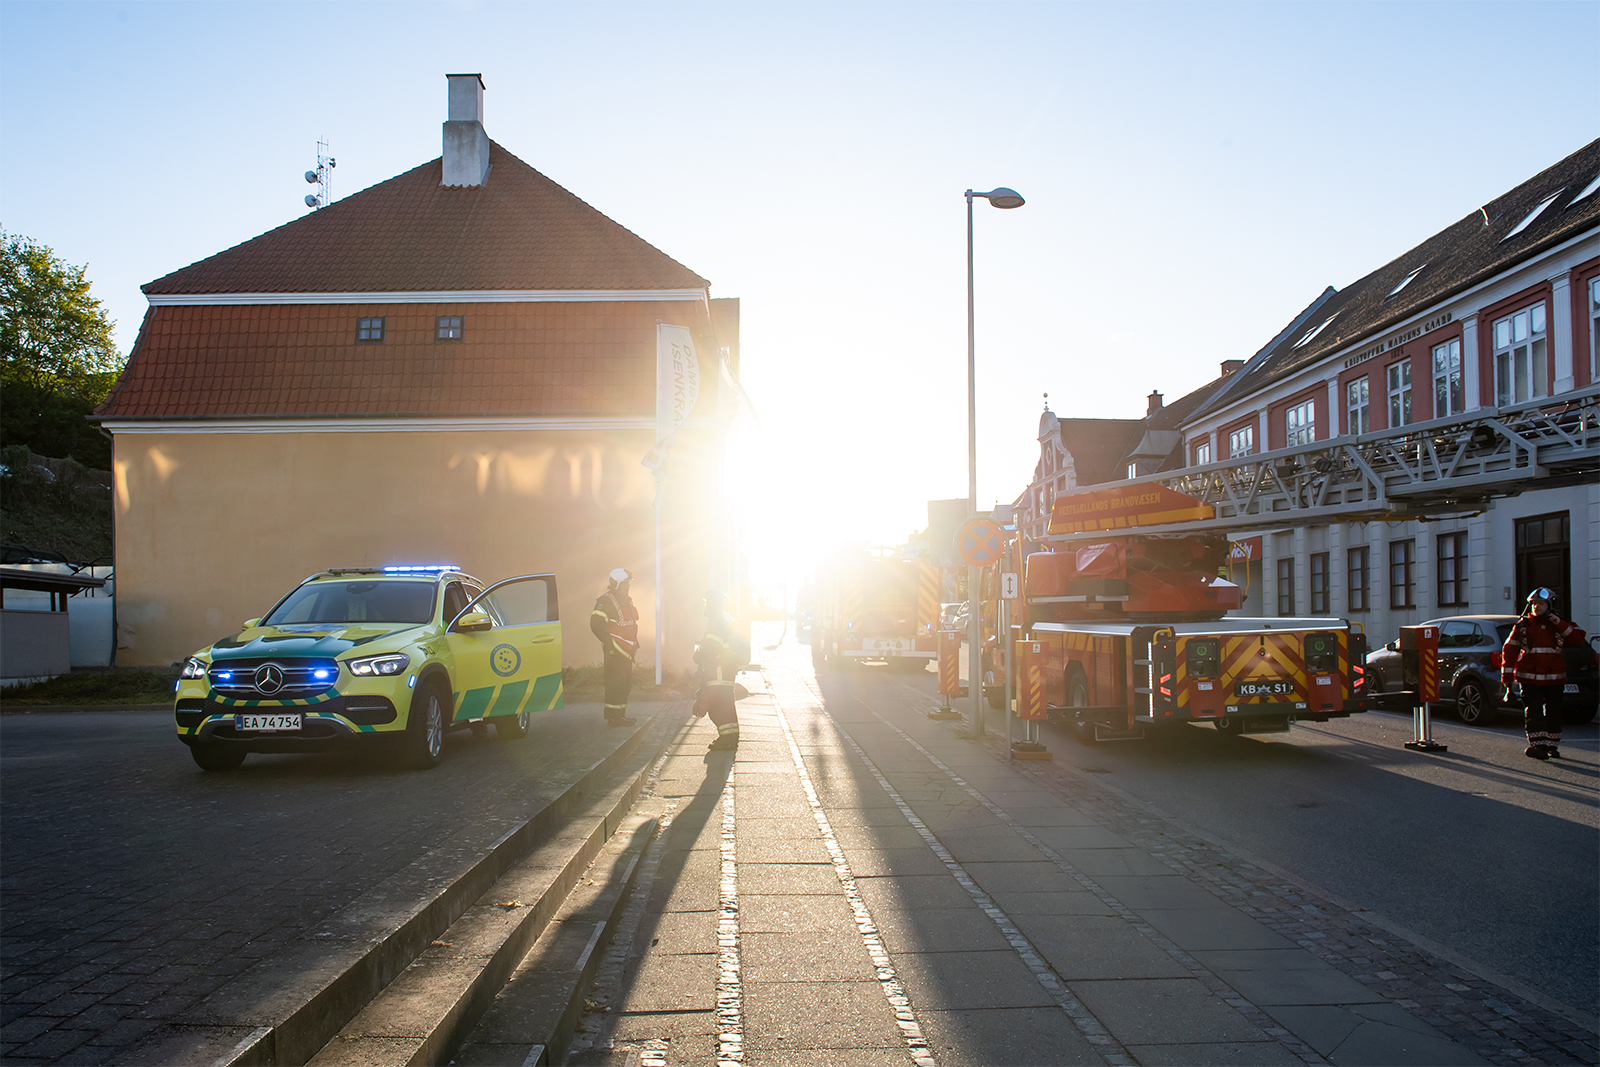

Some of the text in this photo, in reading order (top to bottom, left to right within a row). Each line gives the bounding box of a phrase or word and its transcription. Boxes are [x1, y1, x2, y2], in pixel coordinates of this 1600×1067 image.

[1388, 327, 1421, 349] MADSENS
[1425, 312, 1452, 332] GAARD
[1058, 492, 1160, 516] VESTSJÆLLANDS BRANDVÆSEN
[1241, 684, 1256, 694] KB
